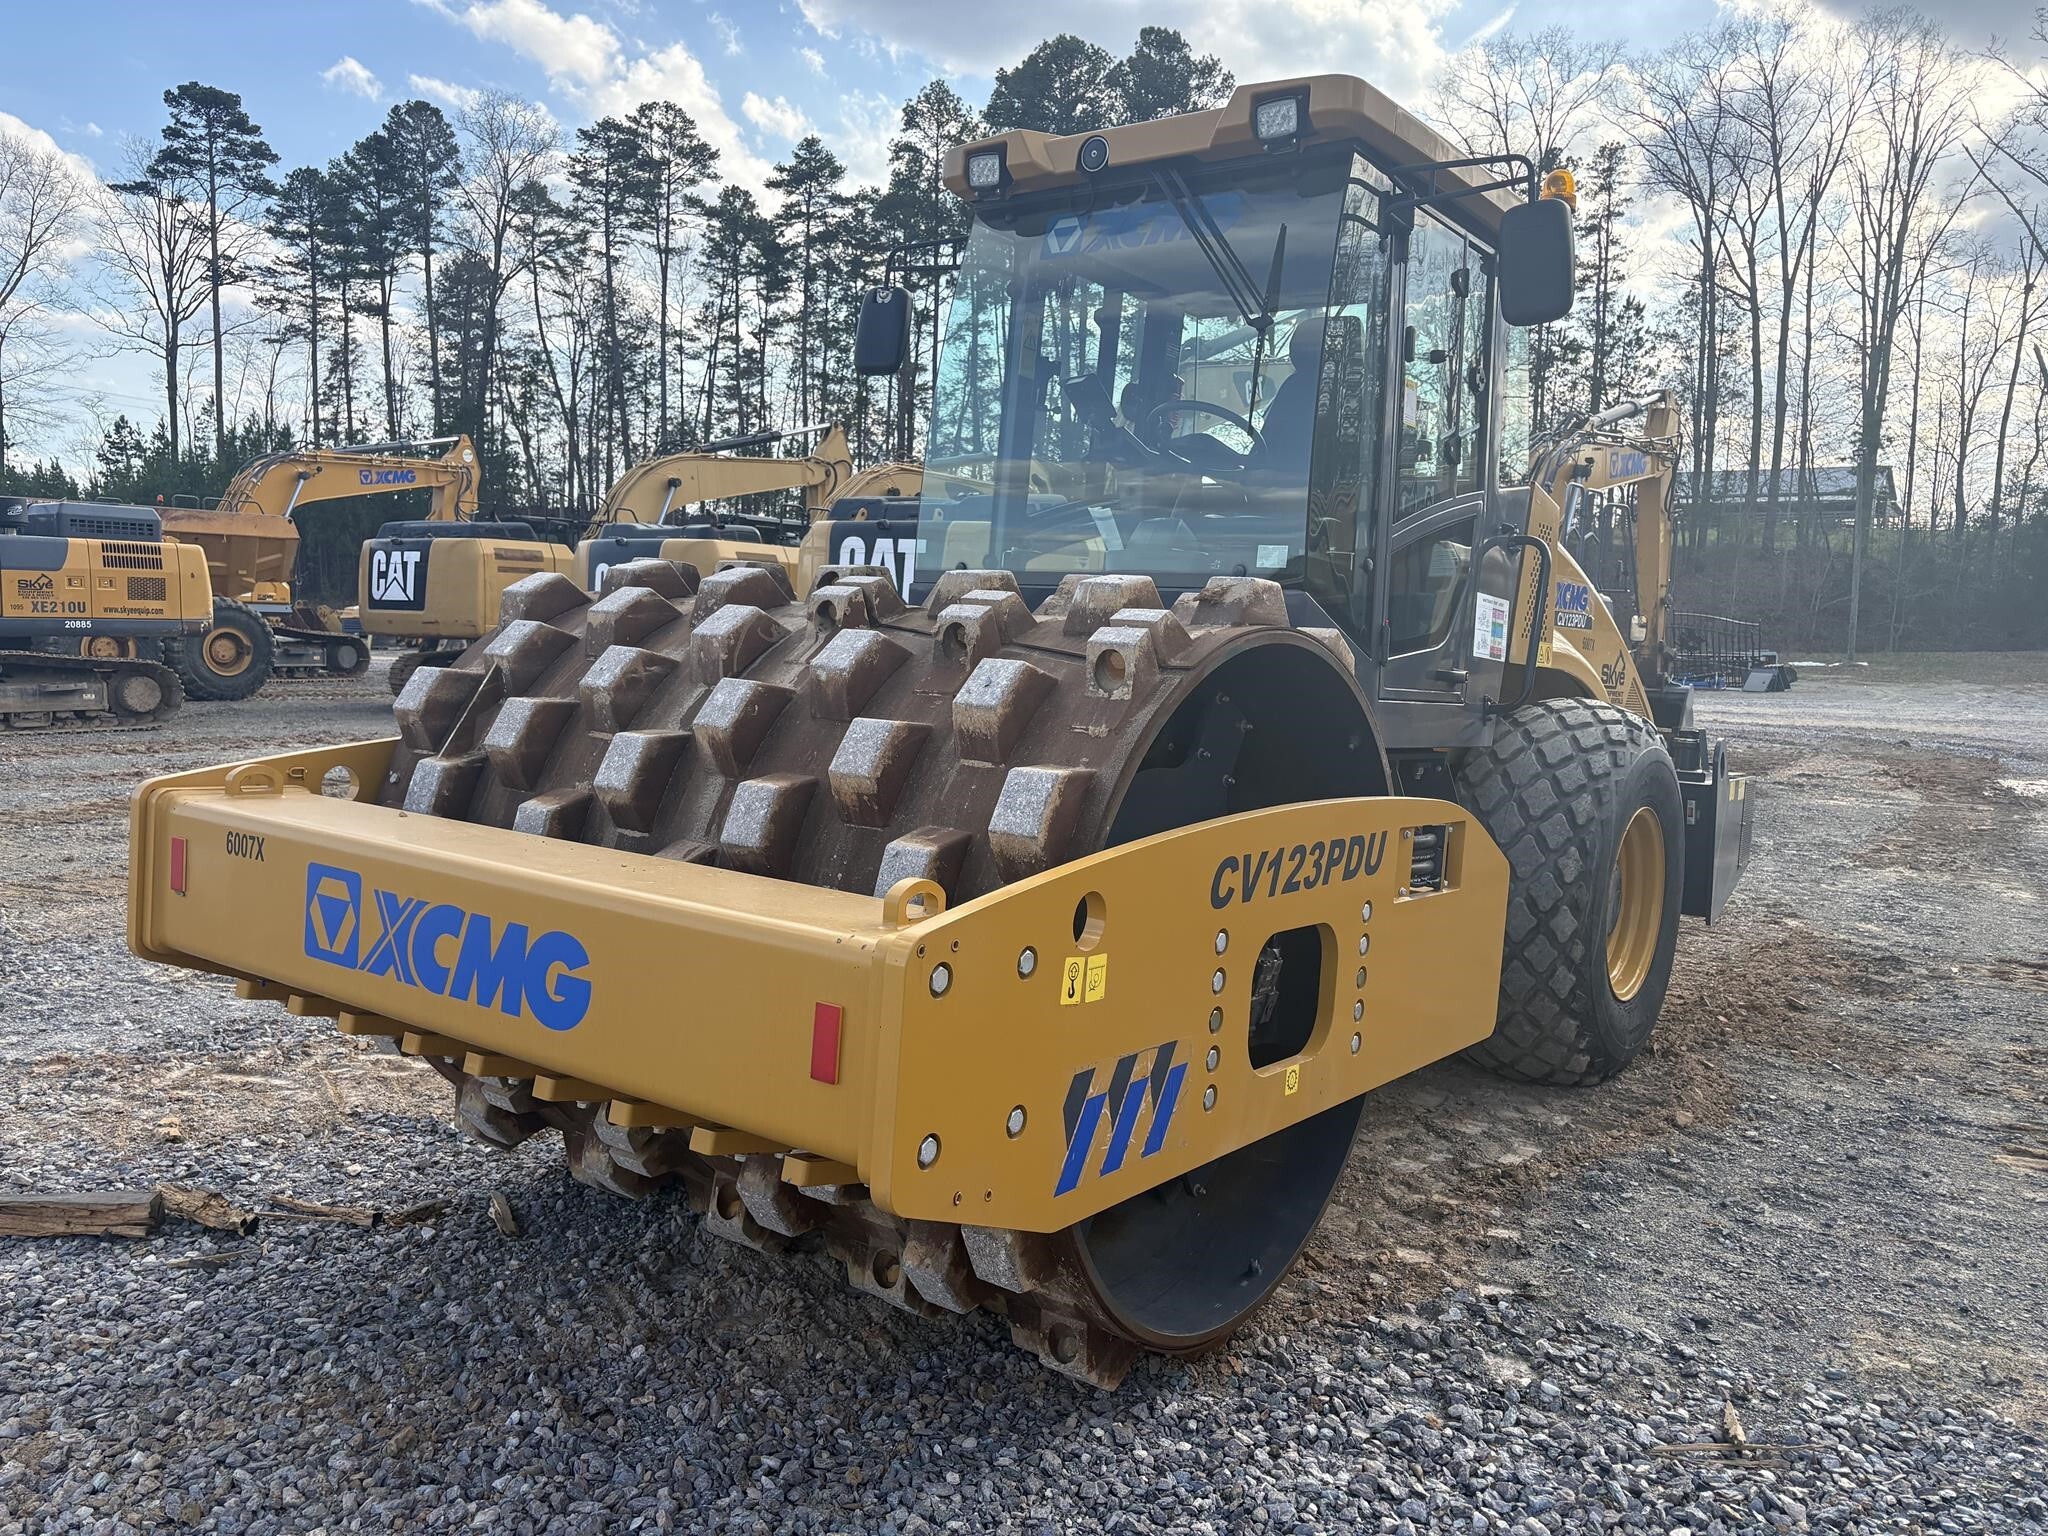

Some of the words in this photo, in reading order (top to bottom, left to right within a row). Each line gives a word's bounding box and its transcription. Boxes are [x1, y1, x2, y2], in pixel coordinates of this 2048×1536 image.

[1245, 376, 1264, 404] CT
[372, 470, 417, 484] XCMG
[17, 576, 54, 590] Skye
[371, 550, 421, 601] CAT
[31, 601, 86, 613] XE210U
[103, 605, 164, 616] www.skyeequip.com
[1556, 581, 1589, 612] XCMG
[64, 620, 92, 628] 20885
[1557, 612, 1587, 628] CV123PDU
[1600, 657, 1625, 689] Skye
[225, 830, 265, 863] 6007X
[1210, 831, 1389, 910] CV123PDU
[358, 888, 592, 1031] XCMG
